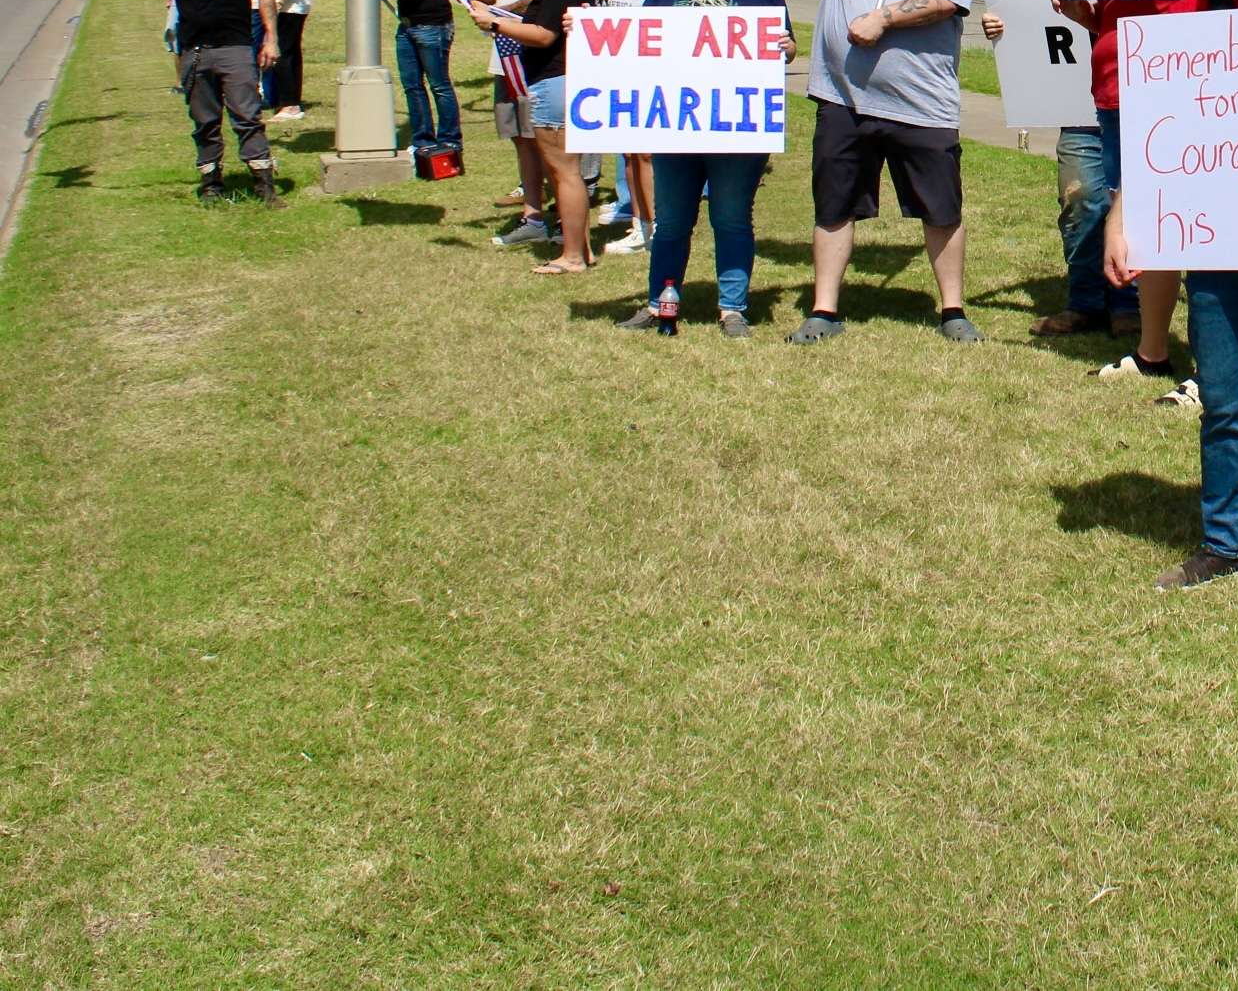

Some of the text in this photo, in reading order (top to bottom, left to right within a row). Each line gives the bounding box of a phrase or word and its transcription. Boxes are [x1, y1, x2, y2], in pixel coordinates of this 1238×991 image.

[580, 15, 782, 60] WE ARE
[570, 85, 784, 133] CHARLIE
[1158, 188, 1215, 254] his
